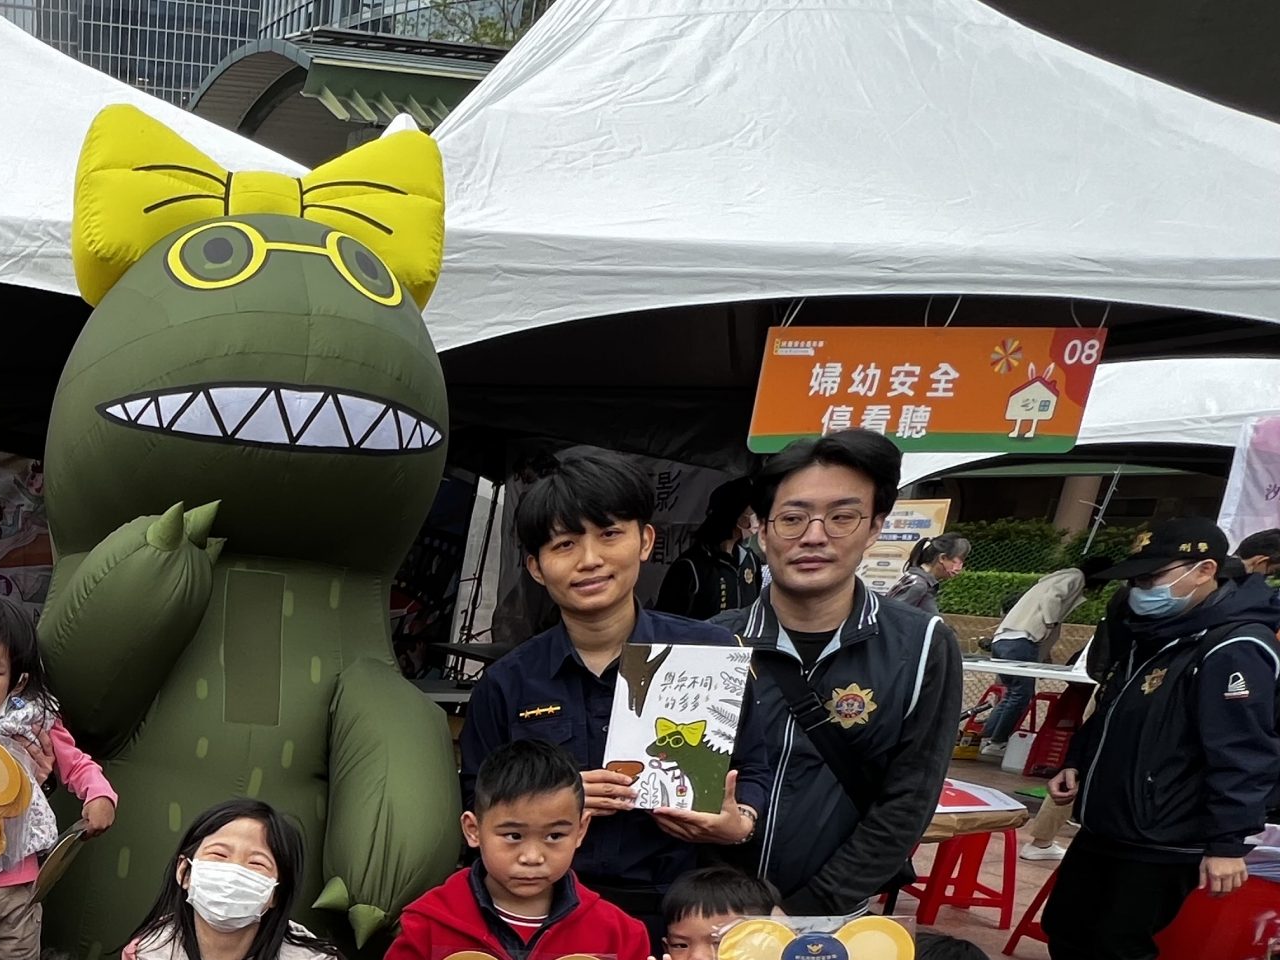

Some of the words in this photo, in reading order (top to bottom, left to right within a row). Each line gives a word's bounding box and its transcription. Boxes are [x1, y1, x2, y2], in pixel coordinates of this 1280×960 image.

[1063, 339, 1099, 365] 08
[808, 363, 960, 398] 婦幼安全
